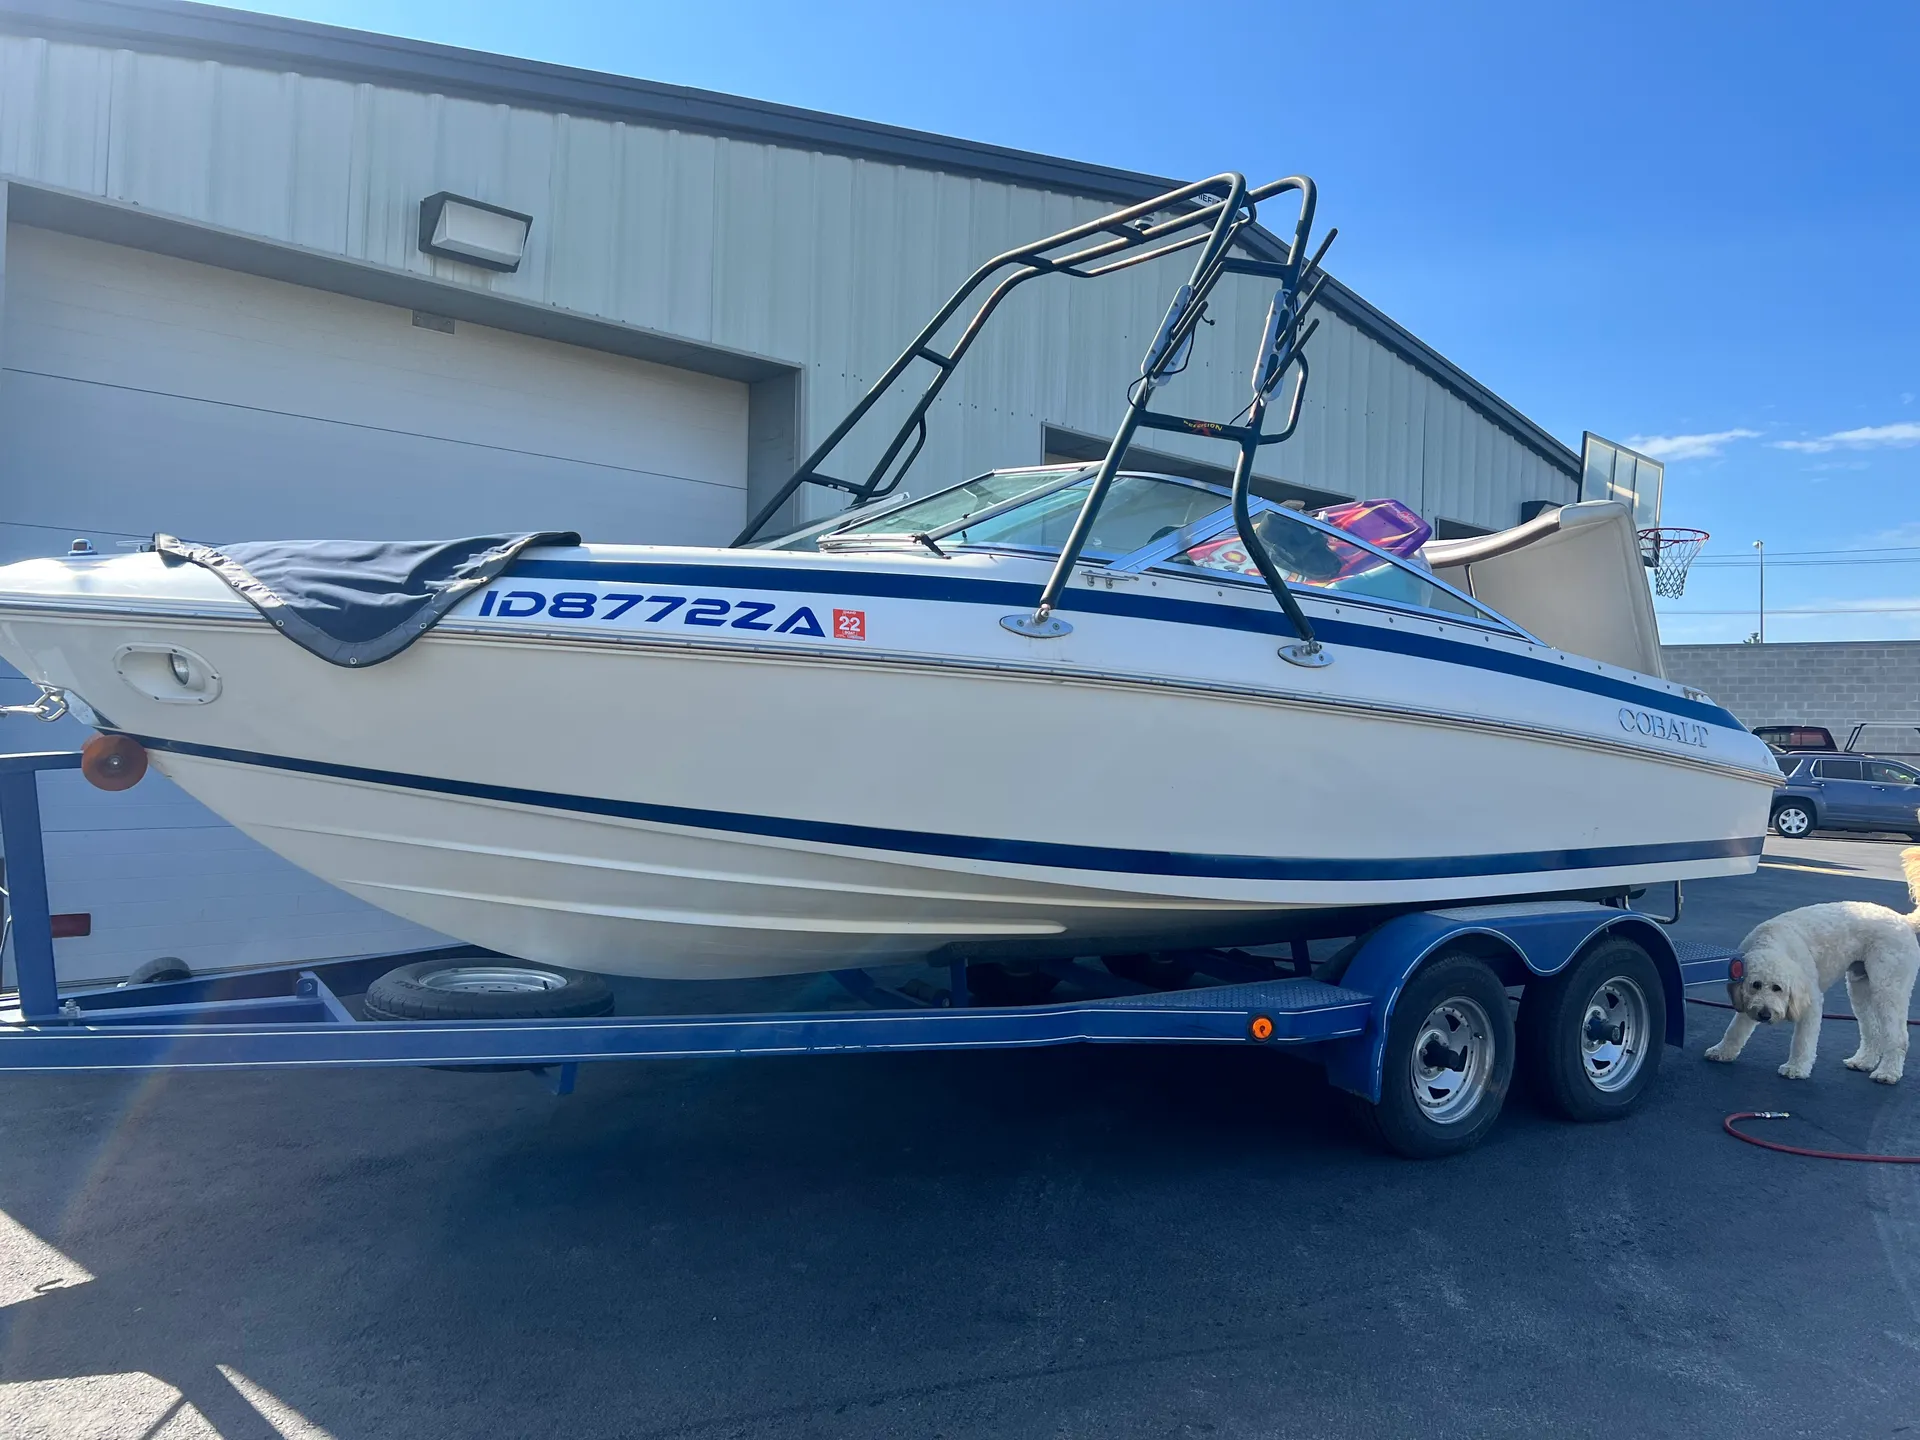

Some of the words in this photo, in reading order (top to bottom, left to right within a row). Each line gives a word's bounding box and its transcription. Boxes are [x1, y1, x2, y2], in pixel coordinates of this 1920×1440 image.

[478, 590, 826, 638] ID8772ZA
[839, 615, 860, 632] 22
[1618, 707, 1709, 748] COBALT
